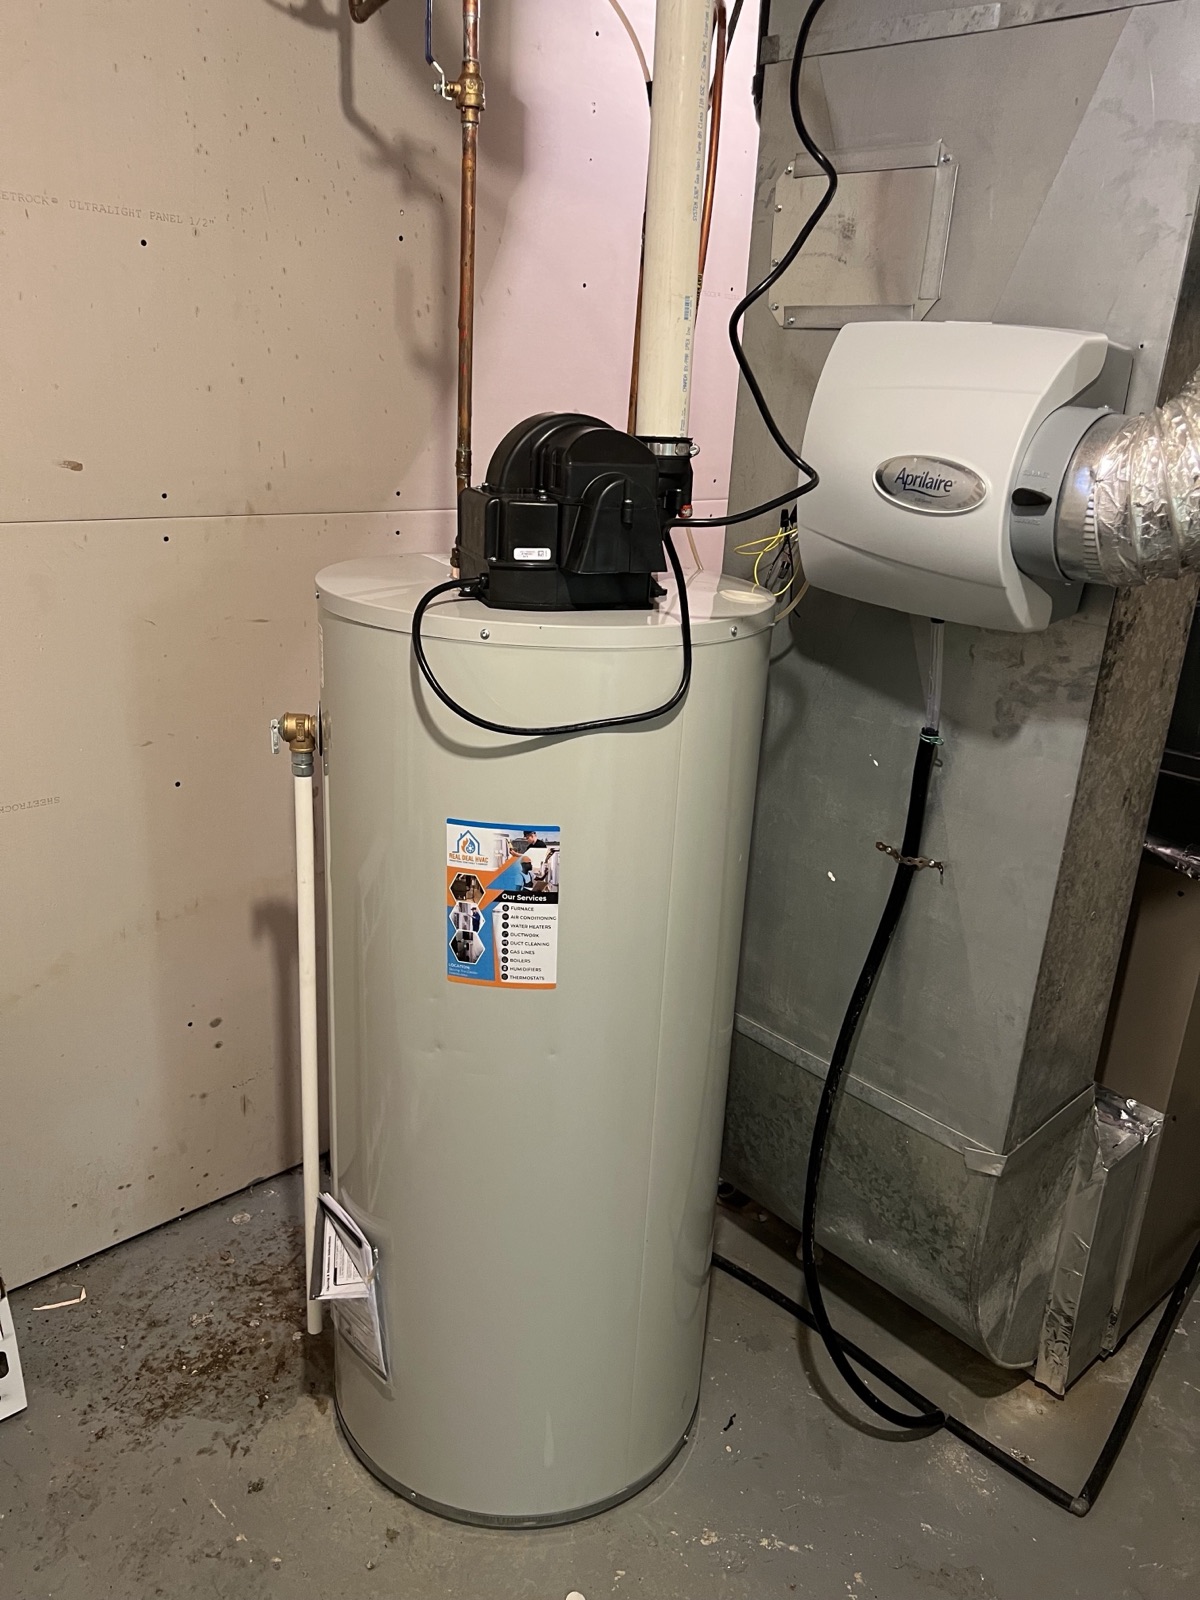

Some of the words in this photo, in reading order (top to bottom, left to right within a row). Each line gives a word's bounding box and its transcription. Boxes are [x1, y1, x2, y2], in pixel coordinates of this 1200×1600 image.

[0, 190, 59, 206] ETROCK®
[69, 199, 142, 219] ULTRALIGHT
[150, 211, 183, 224] PANEL
[449, 852, 461, 861] REAL
[462, 854, 475, 862] DEAL
[516, 894, 547, 902] Services
